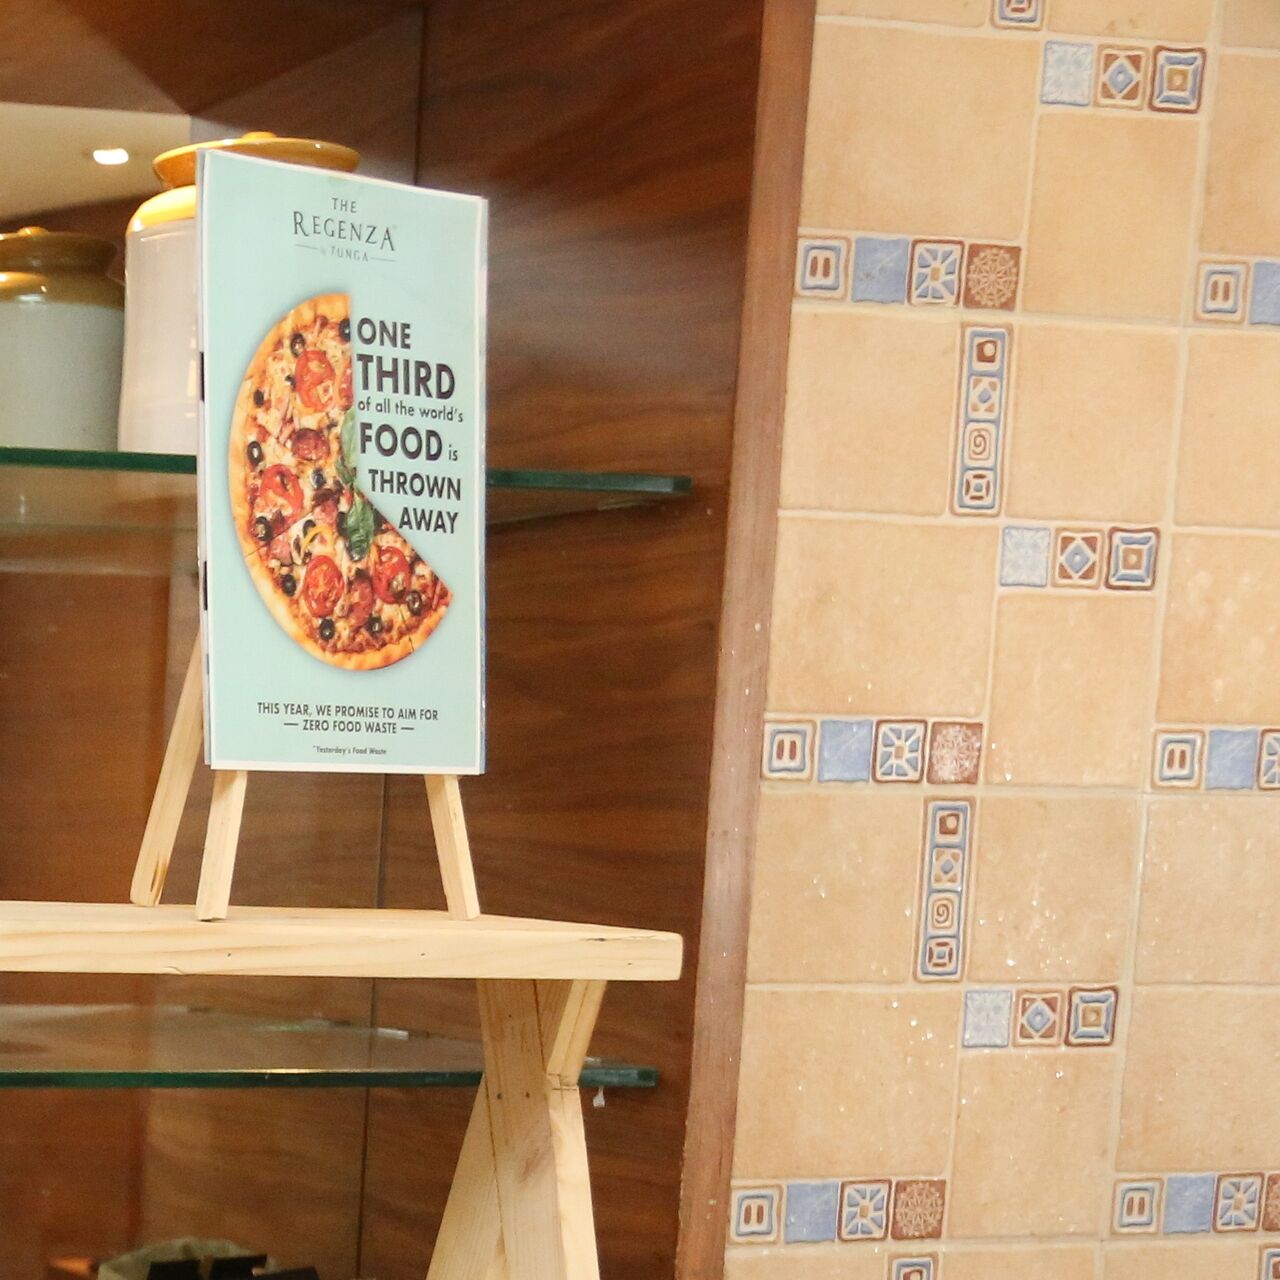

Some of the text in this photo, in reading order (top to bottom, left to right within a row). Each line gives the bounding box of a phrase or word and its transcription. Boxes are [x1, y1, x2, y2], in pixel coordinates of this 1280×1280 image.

[331, 197, 357, 214] THE
[293, 210, 396, 252] REGENZA
[330, 246, 369, 262] TUNGA
[357, 317, 411, 350] ONE
[356, 353, 455, 400] THIRD
[357, 396, 464, 423] of all the world's
[359, 422, 459, 462] FOOD is
[368, 468, 462, 501] THROWN
[398, 506, 459, 535] AWAY
[256, 702, 439, 721] THIS YEAR, WE PROMISE TO AIM FOR
[302, 719, 397, 735] ZERO FOOD WASTE
